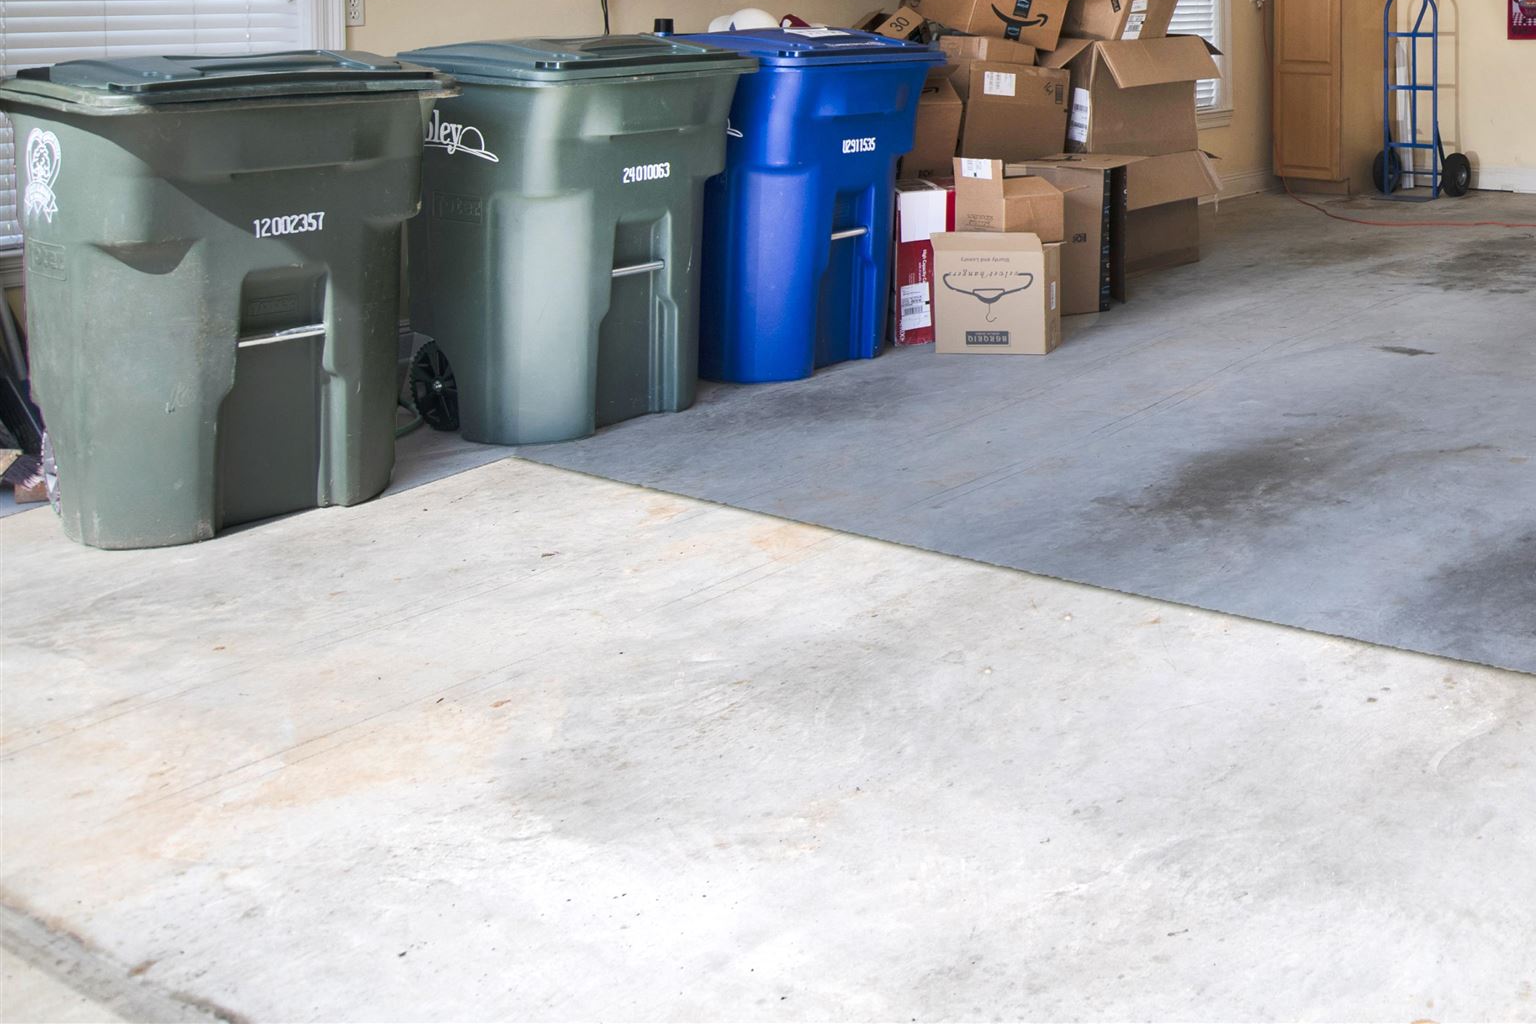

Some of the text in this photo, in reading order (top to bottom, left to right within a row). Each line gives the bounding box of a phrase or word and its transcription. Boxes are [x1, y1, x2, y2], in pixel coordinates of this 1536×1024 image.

[890, 17, 909, 32] 30
[623, 162, 671, 184] 24010063
[254, 212, 325, 238] 12002357
